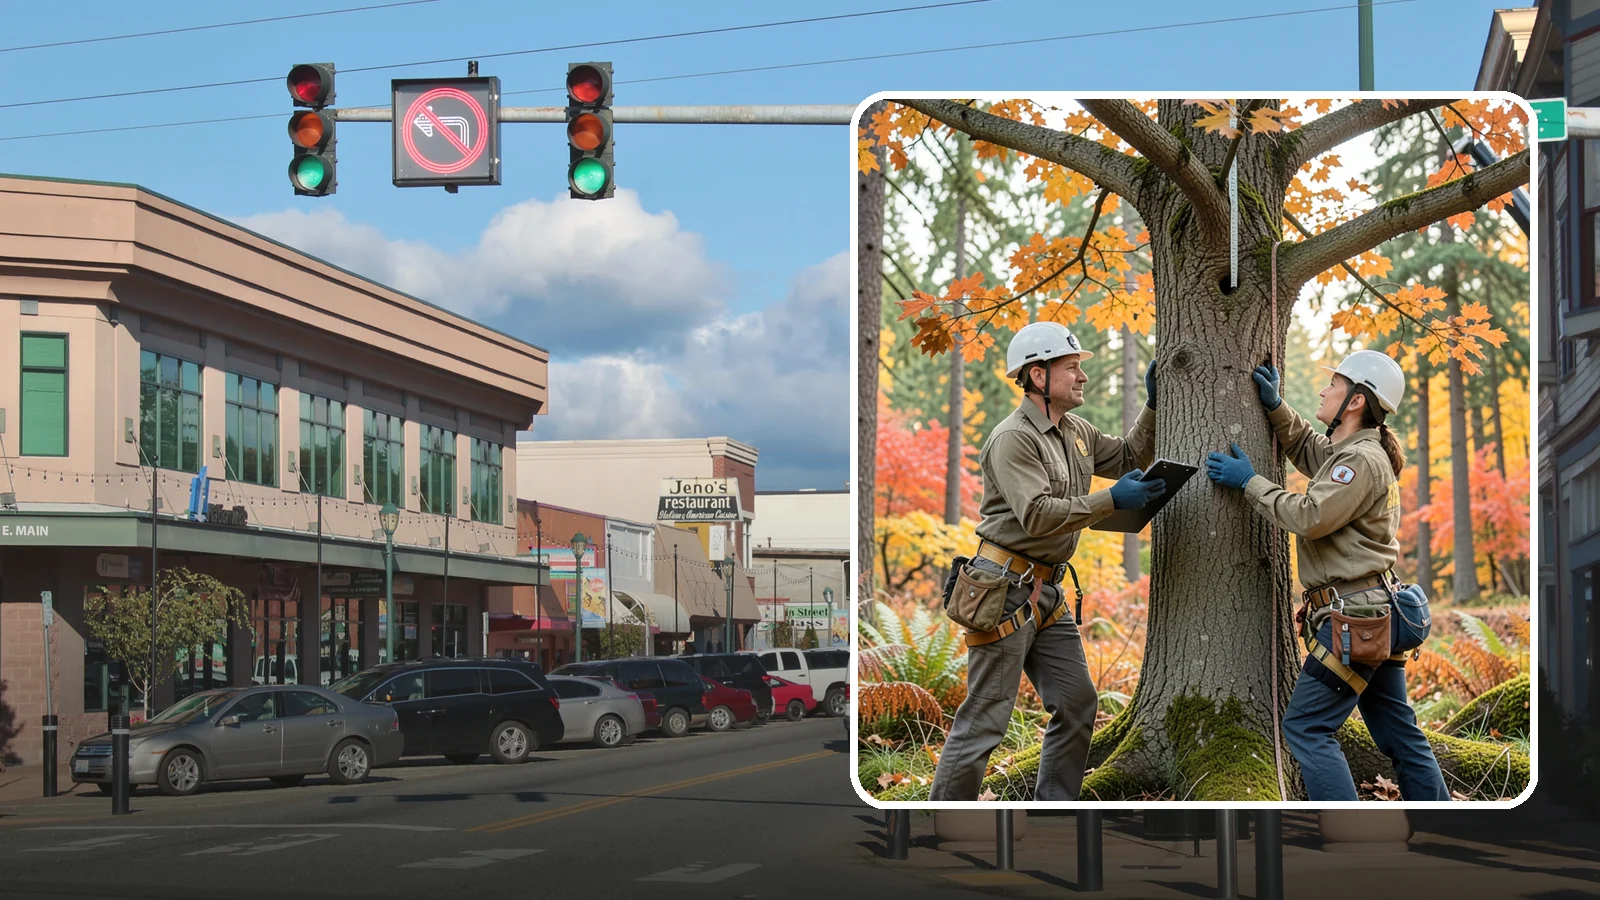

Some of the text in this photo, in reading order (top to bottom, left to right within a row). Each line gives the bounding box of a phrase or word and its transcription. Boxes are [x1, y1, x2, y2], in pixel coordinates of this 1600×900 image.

[670, 480, 727, 494] Jeno's
[665, 496, 731, 509] restaurant
[686, 509, 714, 519] American
[715, 509, 737, 519] Cuisine
[2, 525, 49, 536] E. MAIN
[797, 607, 828, 617] Street
[791, 619, 823, 627] lass
